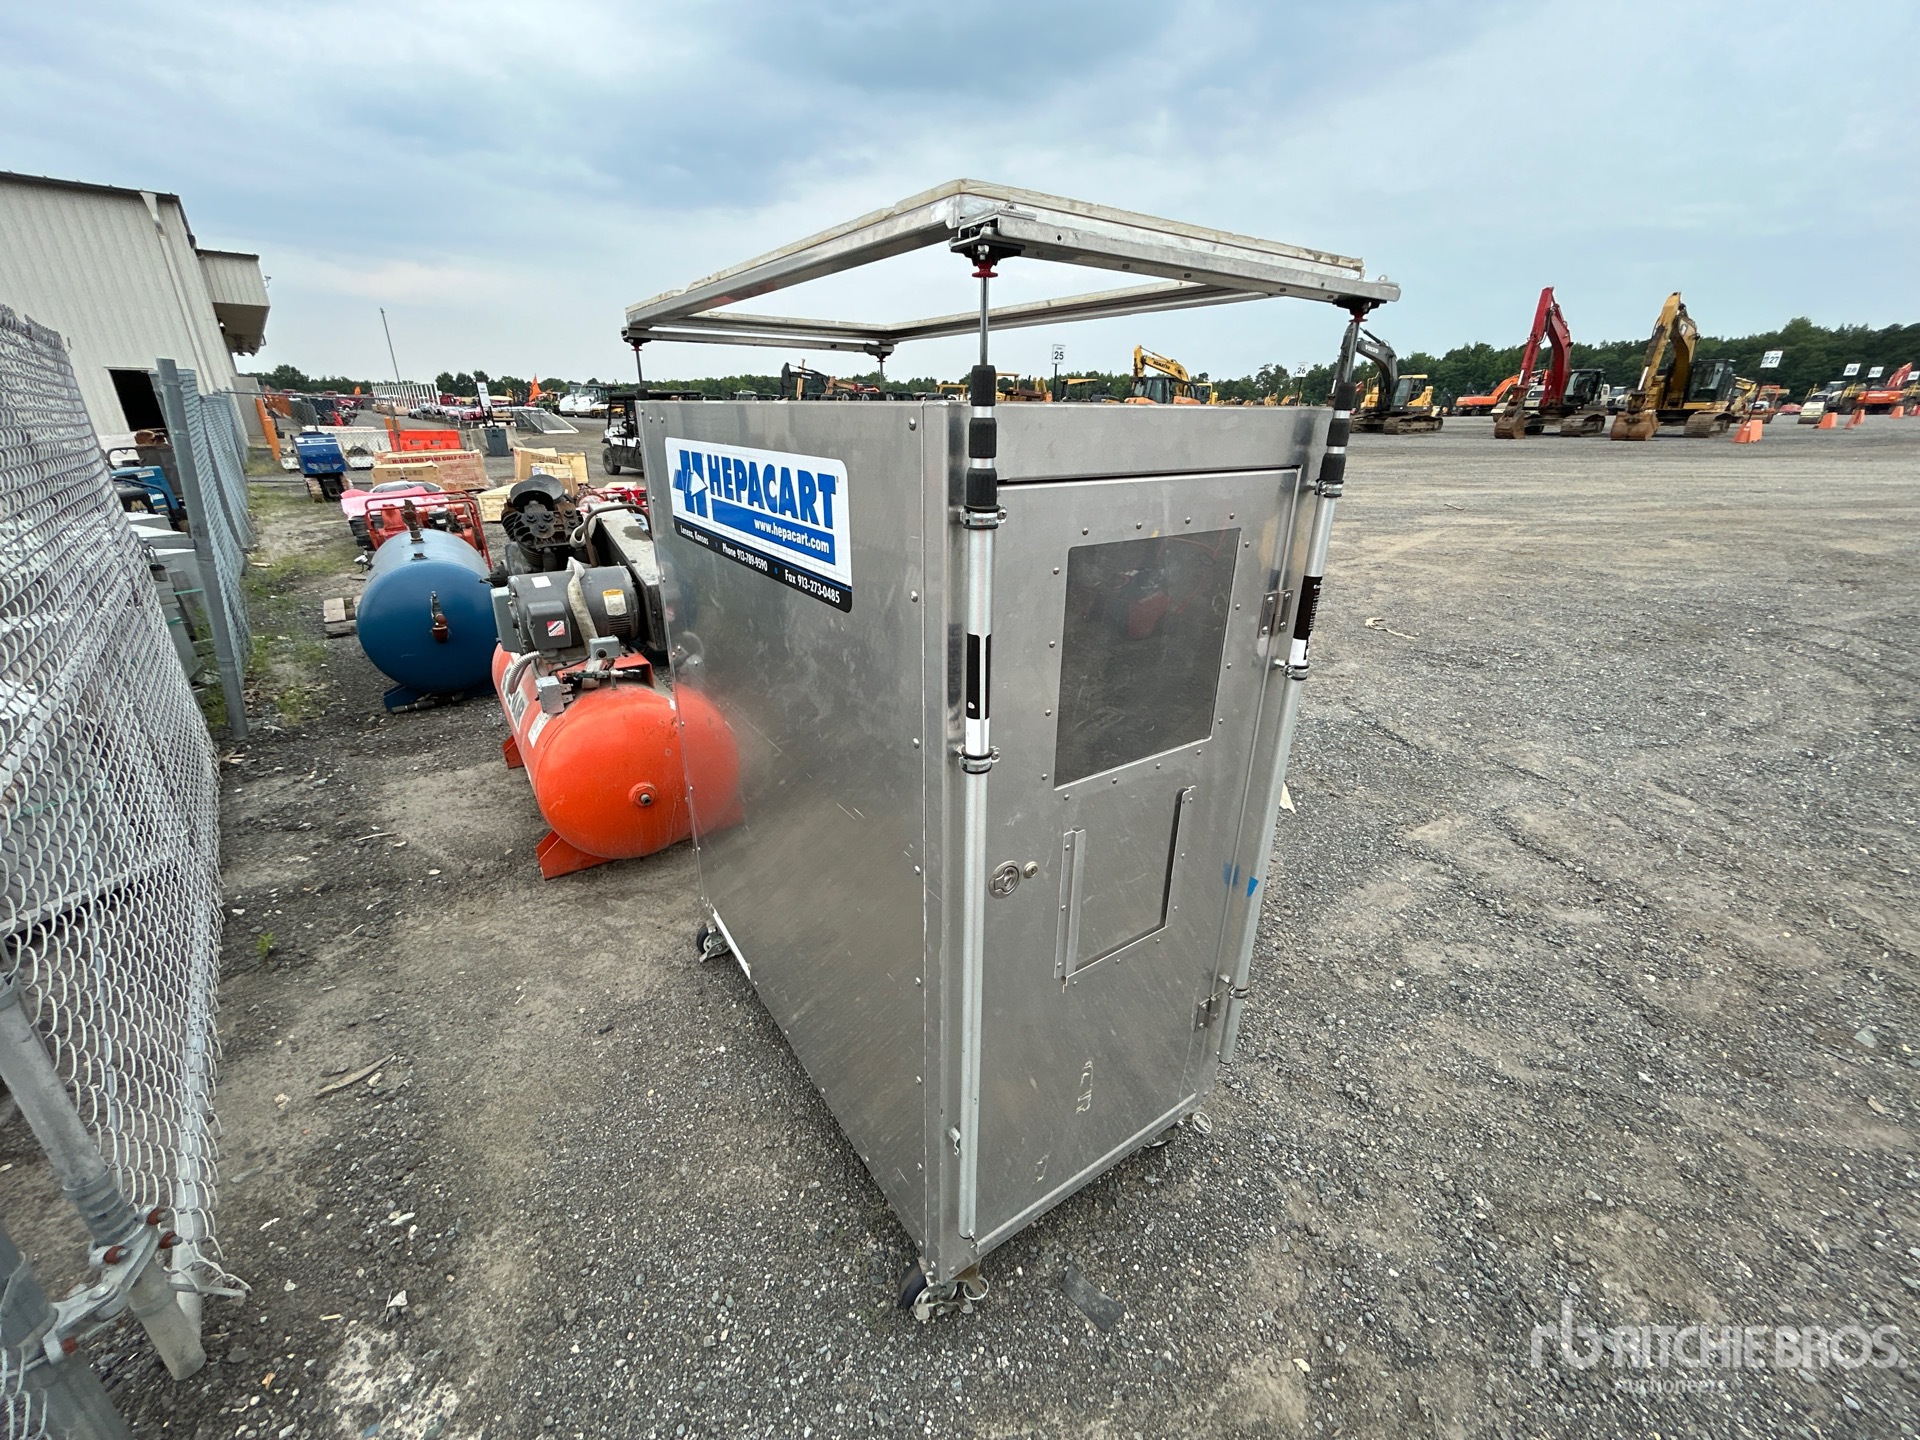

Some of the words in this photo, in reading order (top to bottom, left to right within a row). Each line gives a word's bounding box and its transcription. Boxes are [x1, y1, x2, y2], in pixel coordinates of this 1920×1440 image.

[1054, 351, 1064, 360] 25
[1769, 356, 1780, 364] 27
[706, 454, 836, 529] HEPACART
[753, 519, 830, 554] www.hepacart.com
[694, 531, 709, 546] Kansas
[722, 542, 736, 558] Phone
[736, 549, 768, 572] 913-789-9590
[784, 569, 796, 584] Fax
[797, 574, 841, 604] 913-273-0485
